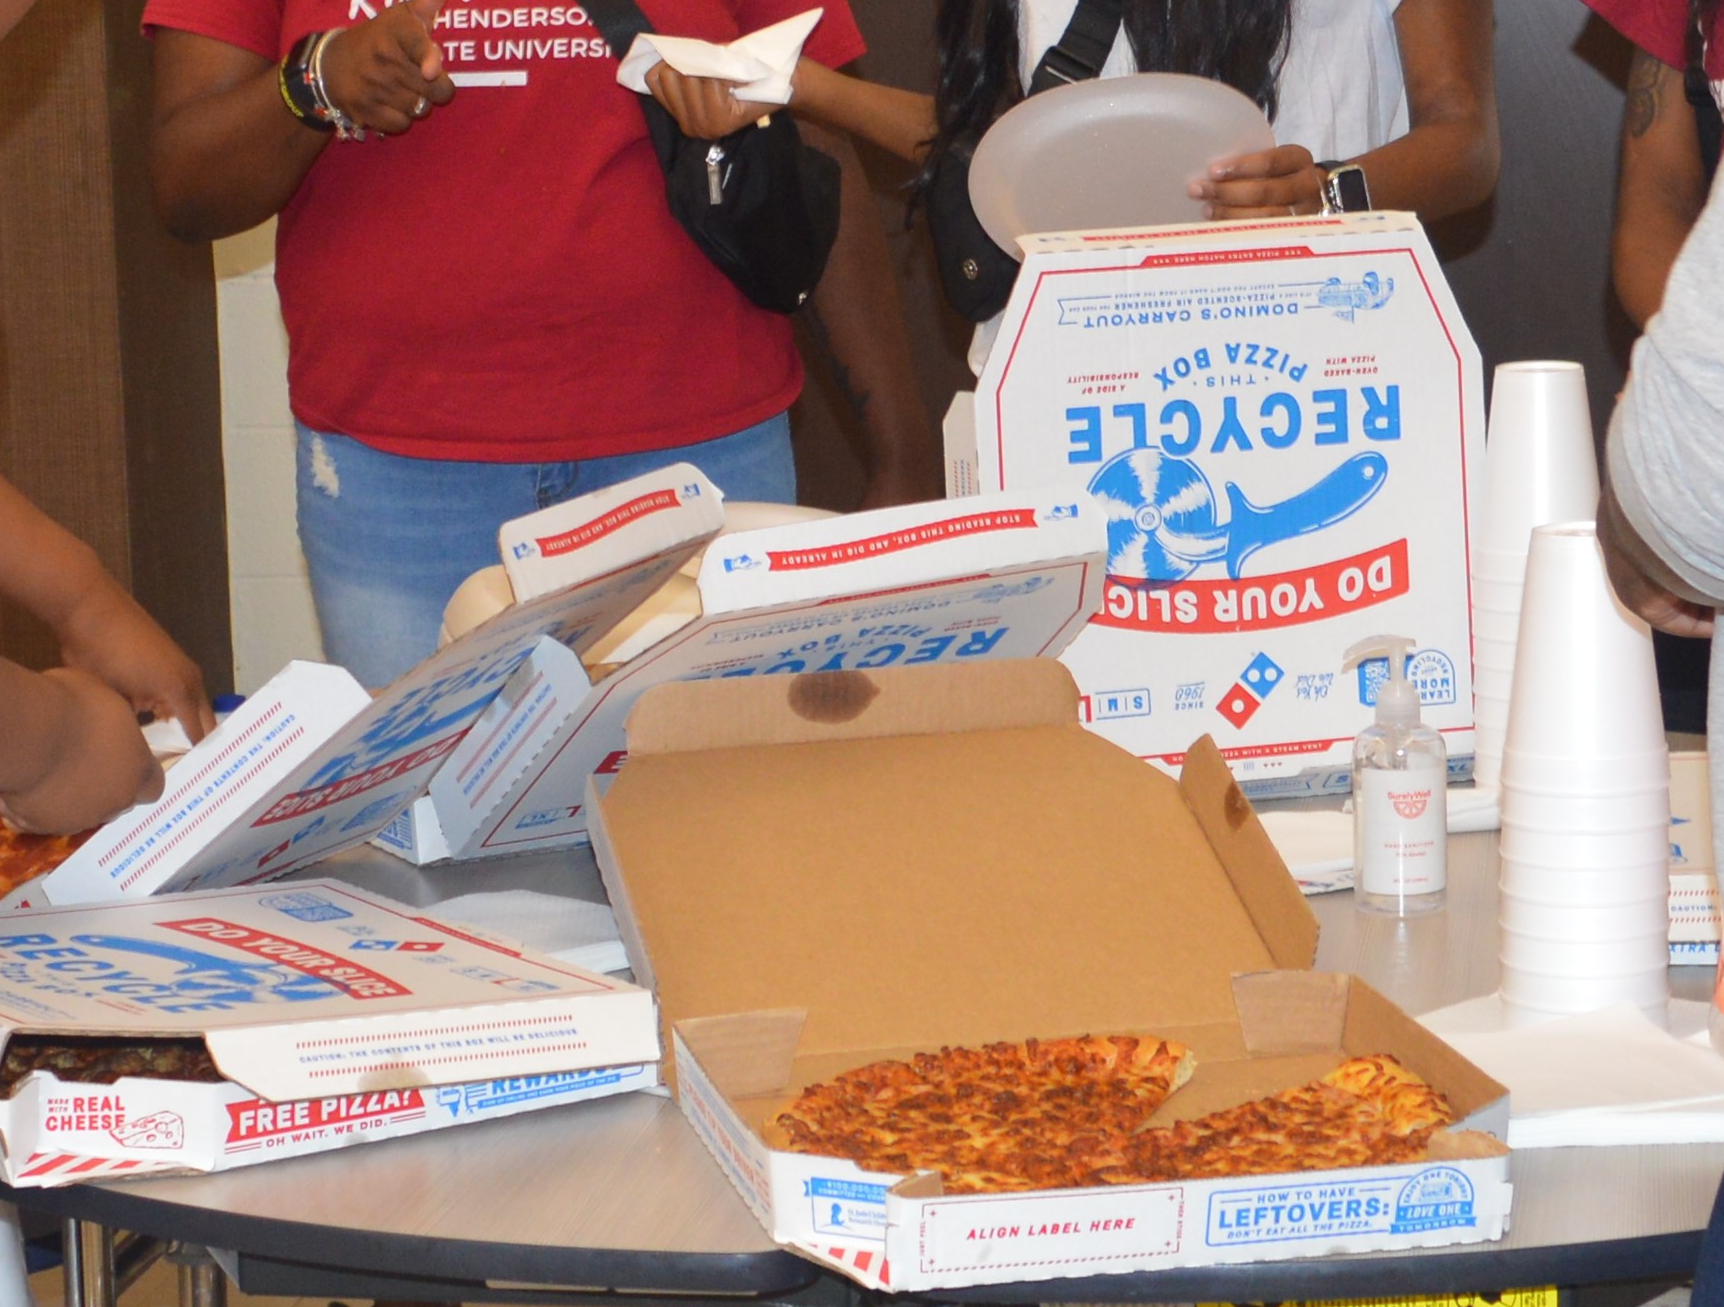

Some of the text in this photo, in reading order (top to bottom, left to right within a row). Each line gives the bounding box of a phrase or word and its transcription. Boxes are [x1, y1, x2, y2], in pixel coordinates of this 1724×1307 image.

[433, 6, 594, 30] HENDERSO
[483, 37, 612, 61] UNIVERSI
[1114, 292, 1275, 310] PIZZA-SCENTED AIR FRESHENER
[1083, 302, 1299, 328] DOMINO'S CARRYOUT
[1153, 342, 1308, 392] PIZZA BOX
[1325, 355, 1376, 366] PIZZA WITH
[1205, 374, 1256, 388] THIS
[1065, 384, 1402, 465] RECYCLE
[947, 516, 992, 533] READING
[994, 514, 1021, 525] STOP
[920, 526, 944, 540] THIS
[846, 544, 865, 556] DIG
[869, 539, 889, 551] AND
[780, 551, 828, 567] ALREADY
[831, 549, 844, 559] IN
[1101, 555, 1392, 625] DO YOUR SLIC
[1174, 686, 1206, 702] 1960
[1420, 689, 1450, 701] LEAR
[1107, 695, 1143, 712] S M
[1174, 702, 1204, 711] SINCE
[248, 742, 263, 757] THE
[1242, 748, 1263, 757] WITH
[1273, 745, 1300, 754] STEAM
[1302, 743, 1324, 751] VENT
[213, 754, 249, 788] CONTENTS
[171, 809, 187, 824] BOX
[154, 823, 173, 840] WILL
[109, 846, 146, 879] DELICIOUS
[1669, 944, 1707, 953] XTRA
[180, 921, 397, 999] DO YOUR SLICE
[299, 1027, 579, 1064] CAUTION: THE CONTENTS OF THIS BOX WILL BE DELICIOUS
[47, 1097, 70, 1106] MADE
[47, 1105, 70, 1114] WITH
[72, 1095, 126, 1114] REAL
[238, 1089, 416, 1137] FREE PIZZA?
[44, 1113, 126, 1132] CHEESE
[265, 1119, 388, 1149] OH WAIT. WE DID.
[1256, 1187, 1356, 1205] HOW TO HAVE
[1403, 1177, 1424, 1204] ENJOY
[1424, 1171, 1442, 1182] ONE
[1218, 1197, 1391, 1230] LEFTOVERS:
[1406, 1204, 1461, 1219] LOVE ONE
[966, 1217, 1136, 1241] ALIGN LABEL HERE
[1227, 1219, 1373, 1239] DON'T EAT ALL THE PIZZA.
[1397, 1218, 1467, 1233] TOMORROW
